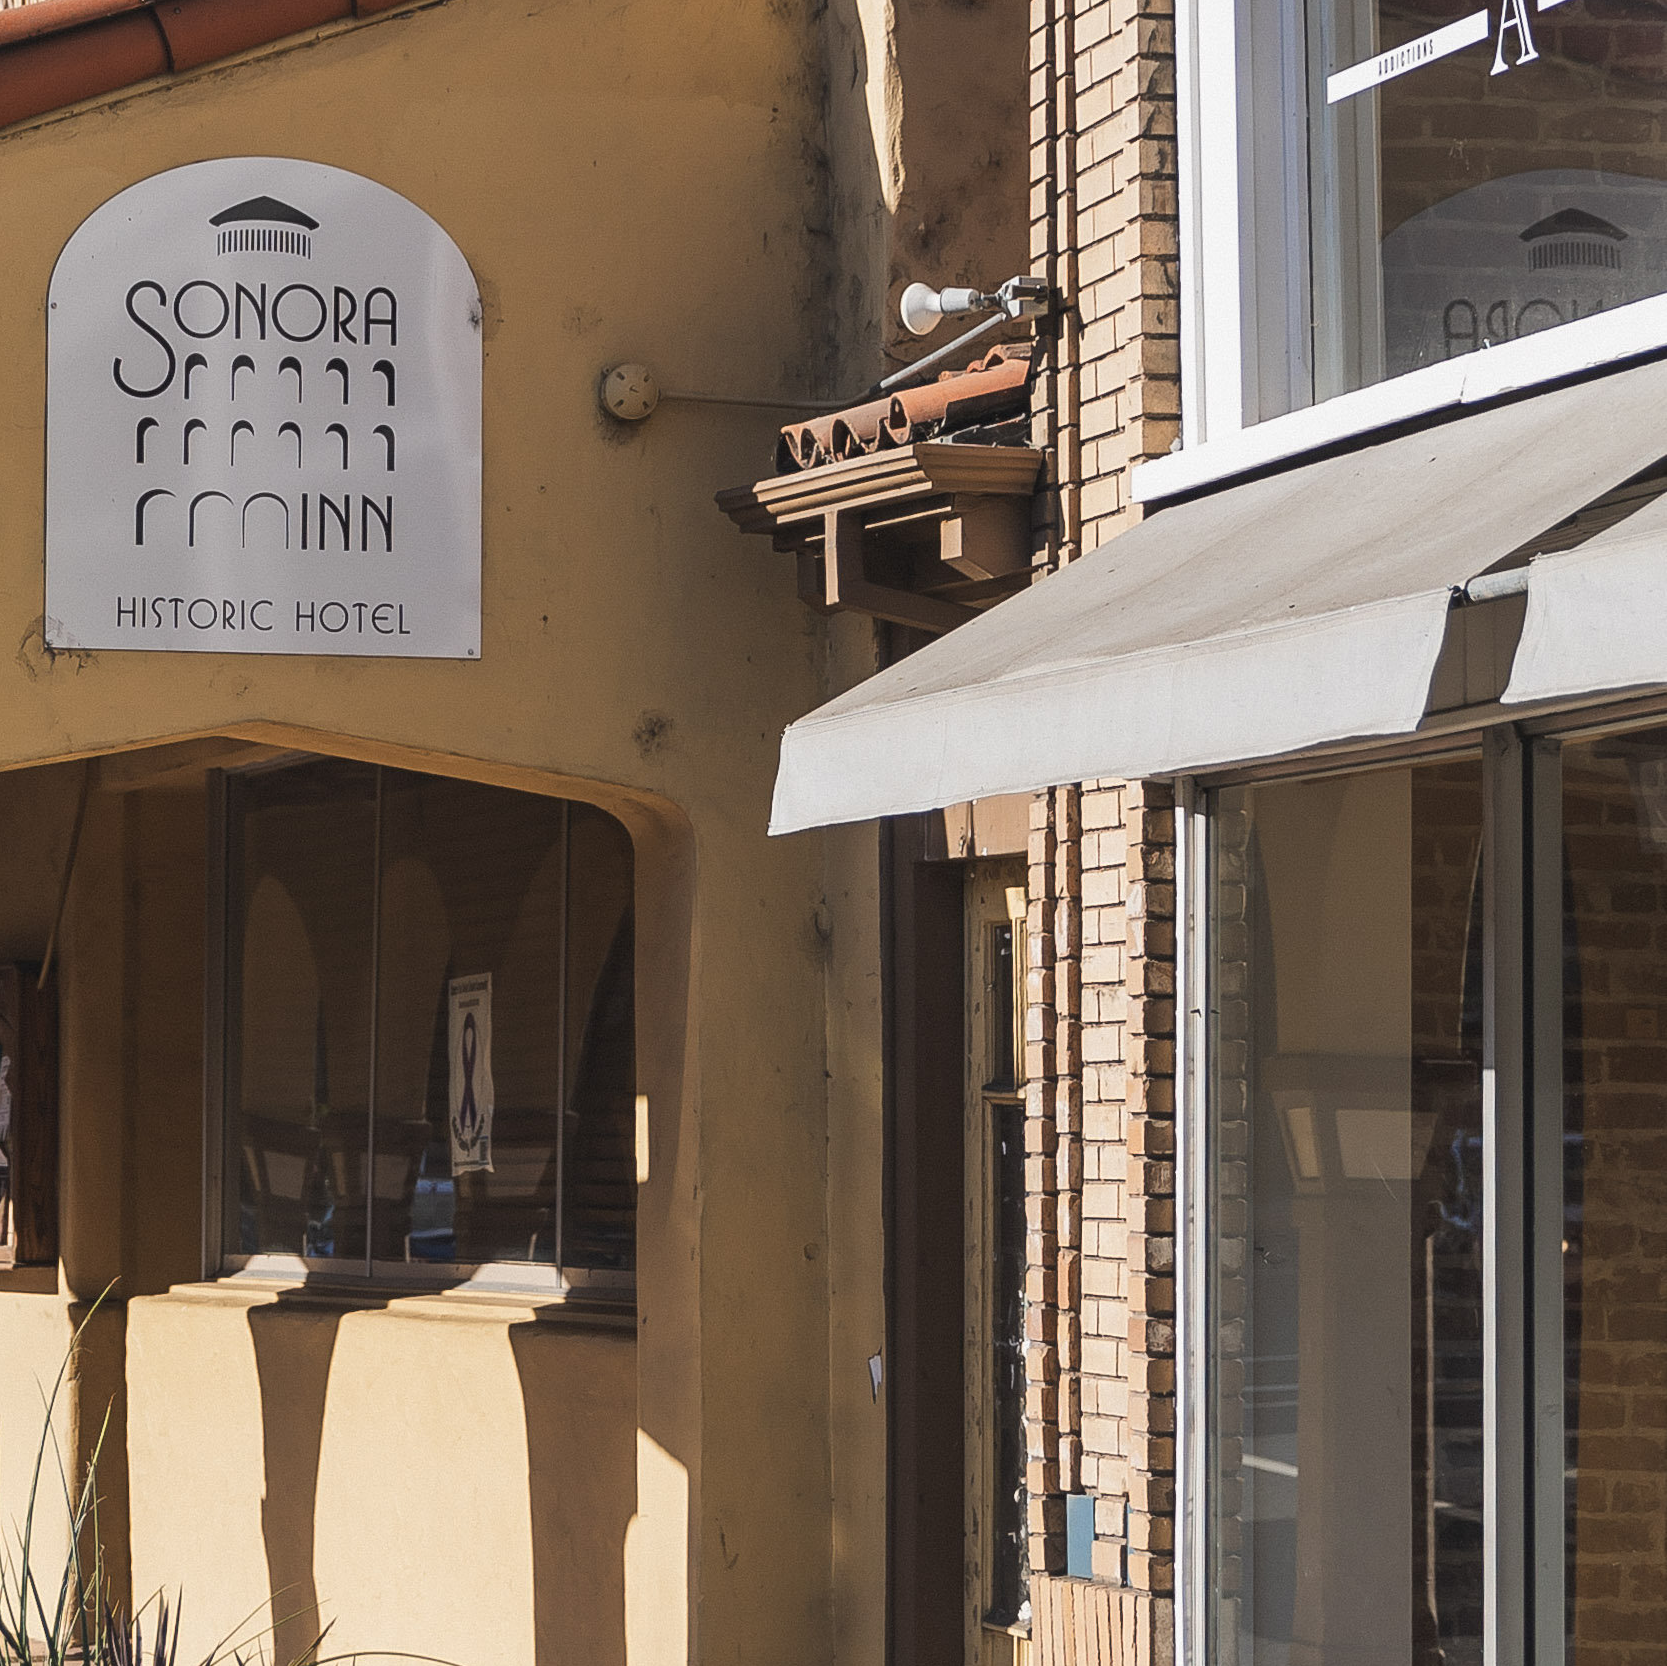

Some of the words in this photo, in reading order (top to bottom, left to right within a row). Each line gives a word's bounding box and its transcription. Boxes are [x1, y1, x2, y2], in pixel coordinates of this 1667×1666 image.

[1378, 38, 1434, 77] ADDICTIONS
[112, 279, 398, 399] SONORA
[300, 492, 393, 552] INN
[115, 595, 274, 632] HISTORIC
[294, 600, 411, 635] HOTEL
